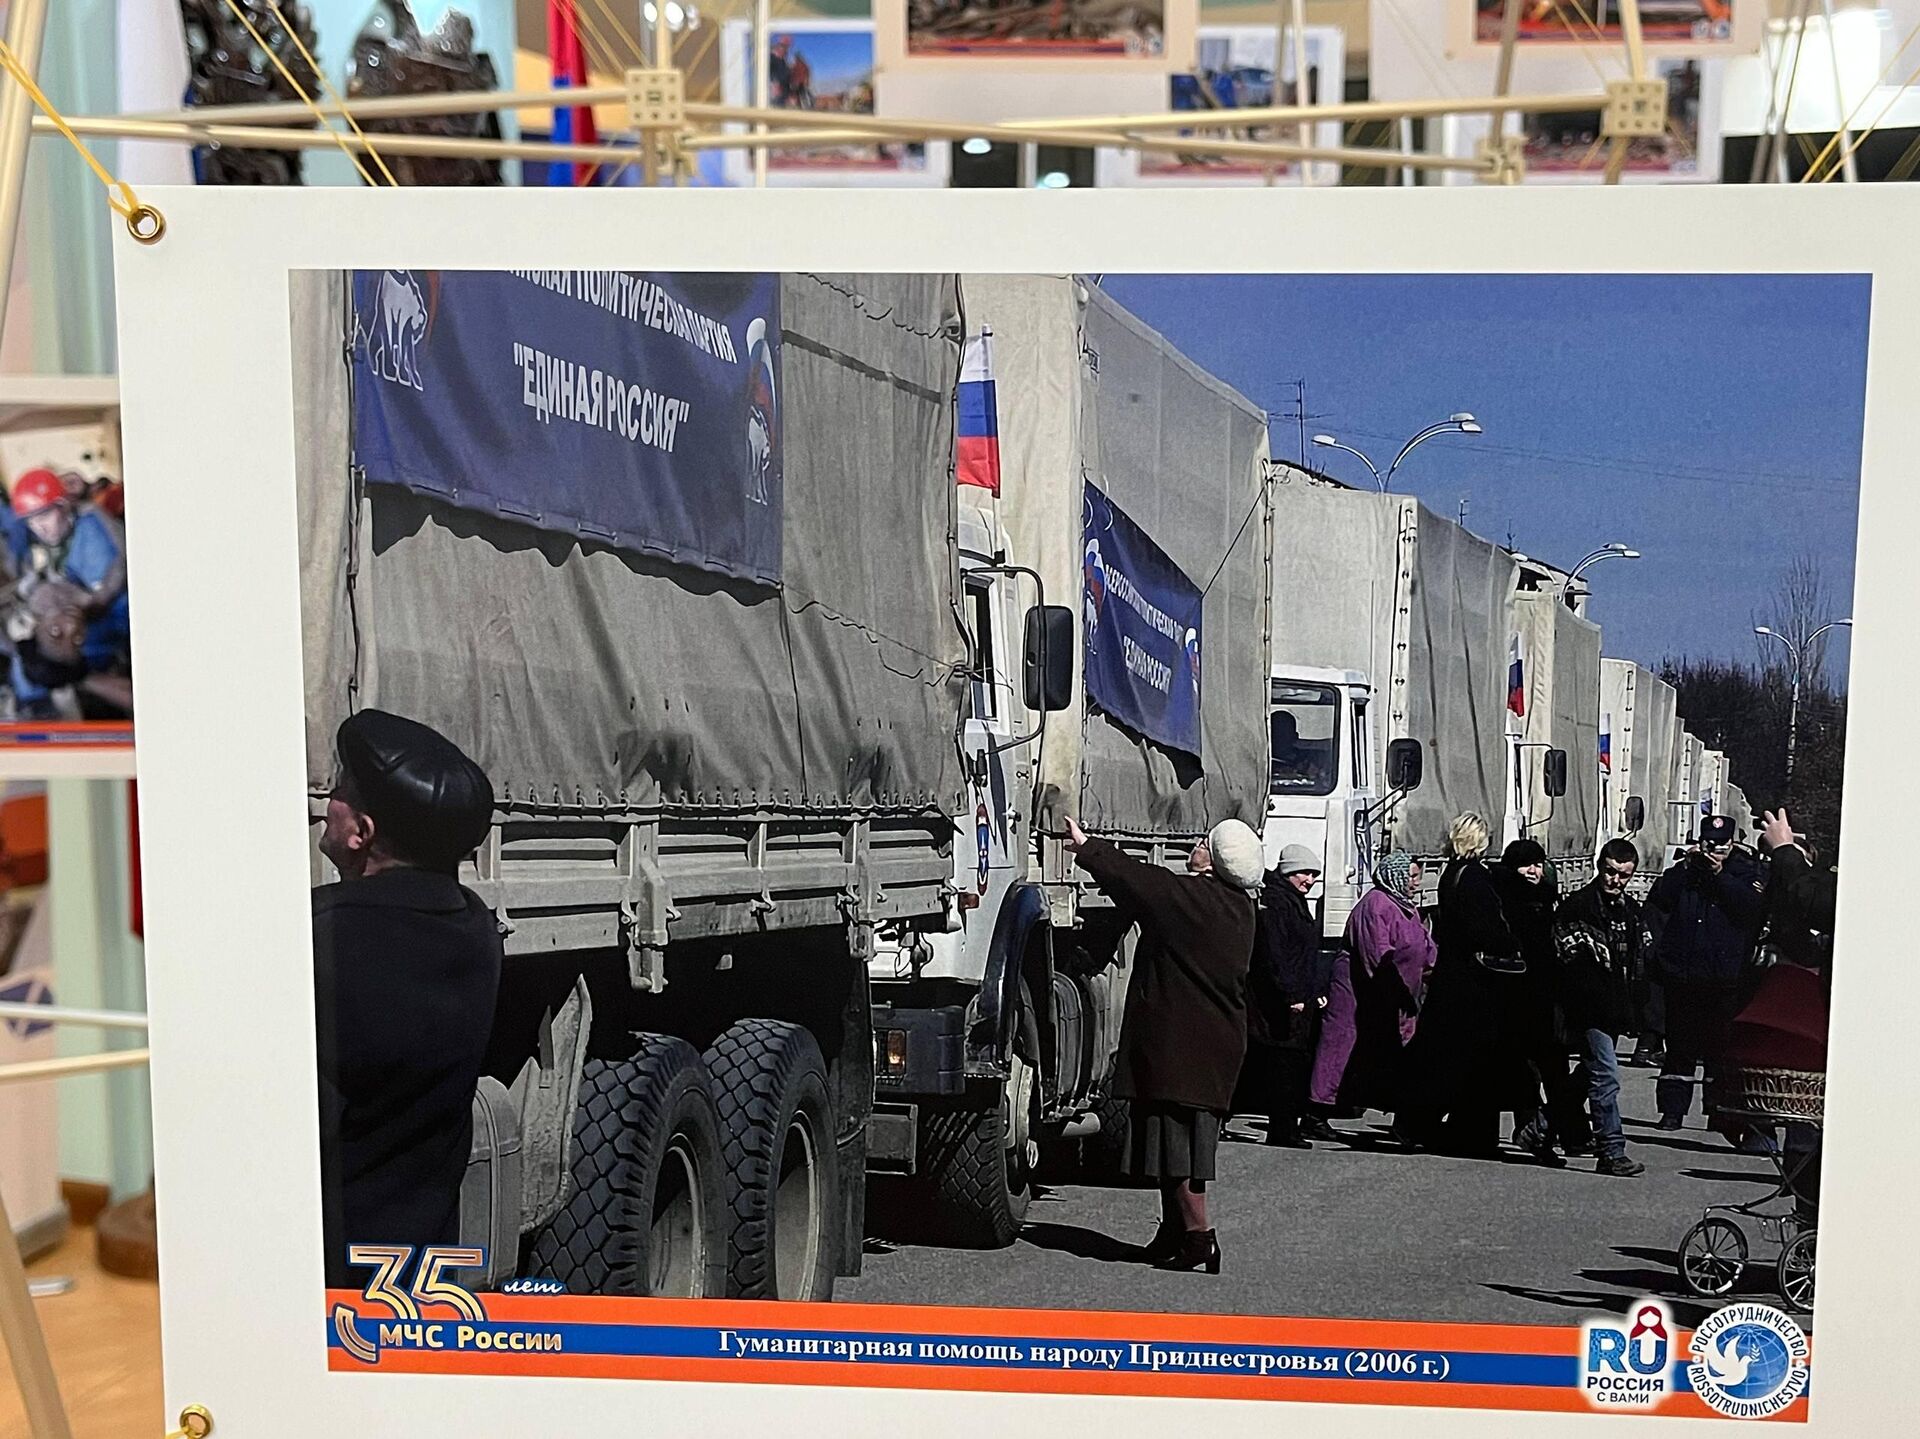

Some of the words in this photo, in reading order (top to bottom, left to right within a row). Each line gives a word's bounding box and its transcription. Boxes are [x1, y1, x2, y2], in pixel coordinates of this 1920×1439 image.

[513, 342, 603, 428] "ЕДИНАЯ
[606, 375, 690, 453] РОССИЯ"
[349, 1245, 485, 1321] 35
[504, 1281, 564, 1294] лет
[379, 1323, 444, 1348] МЧС
[457, 1325, 563, 1351] России
[718, 1330, 914, 1361] Гуманитарная
[919, 1343, 1025, 1369] помощь
[1030, 1346, 1124, 1370] народу
[1128, 1343, 1340, 1375] Приднестровья
[1343, 1350, 1417, 1377] (2006
[1422, 1354, 1451, 1380] г.)
[1588, 1328, 1668, 1375] RU
[1693, 1306, 1809, 1357] РОССОТРУДНИЧЕСТВО
[1586, 1376, 1665, 1393] РОССИЯ
[1596, 1391, 1606, 1403] С
[1609, 1392, 1651, 1405] ВАМИ
[1690, 1366, 1807, 1417] ROSSOTRUDNICHESTVO
